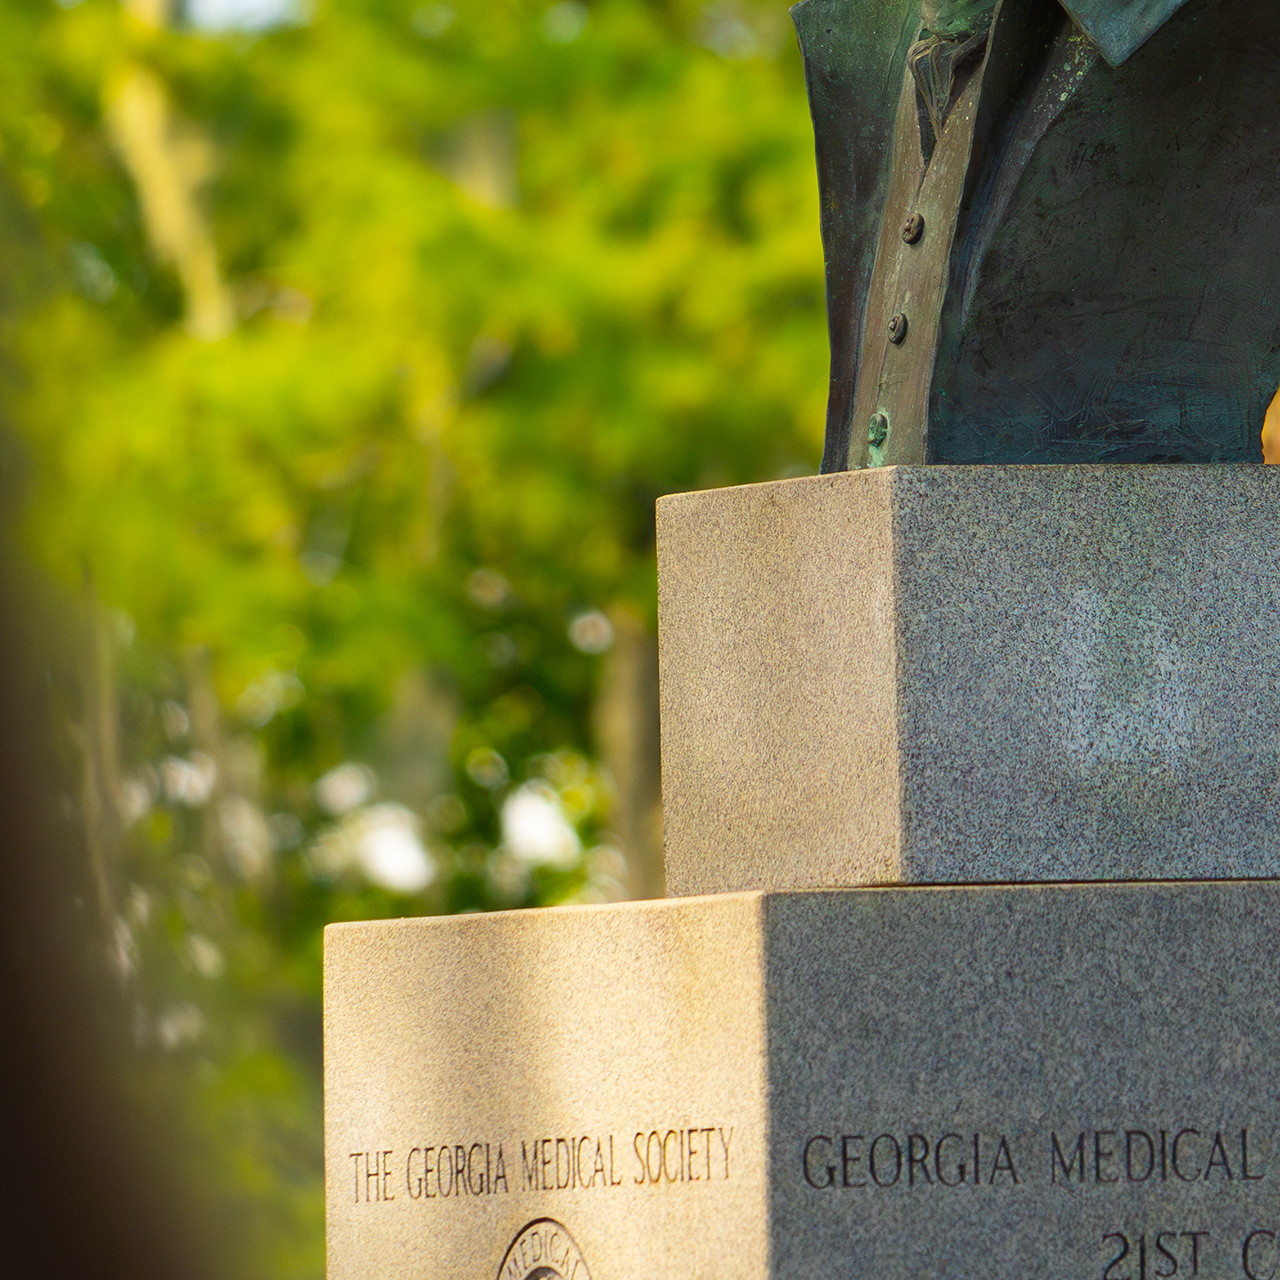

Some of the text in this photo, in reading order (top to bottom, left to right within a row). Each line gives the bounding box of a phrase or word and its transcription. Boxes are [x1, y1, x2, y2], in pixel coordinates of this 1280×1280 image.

[349, 1127, 734, 1204] THE GEORGIA MEDICAL SOCIETY
[802, 1133, 1020, 1189] GEORGIA
[1050, 1128, 1265, 1184] MEDICAL
[1102, 1231, 1210, 1280] 21ST
